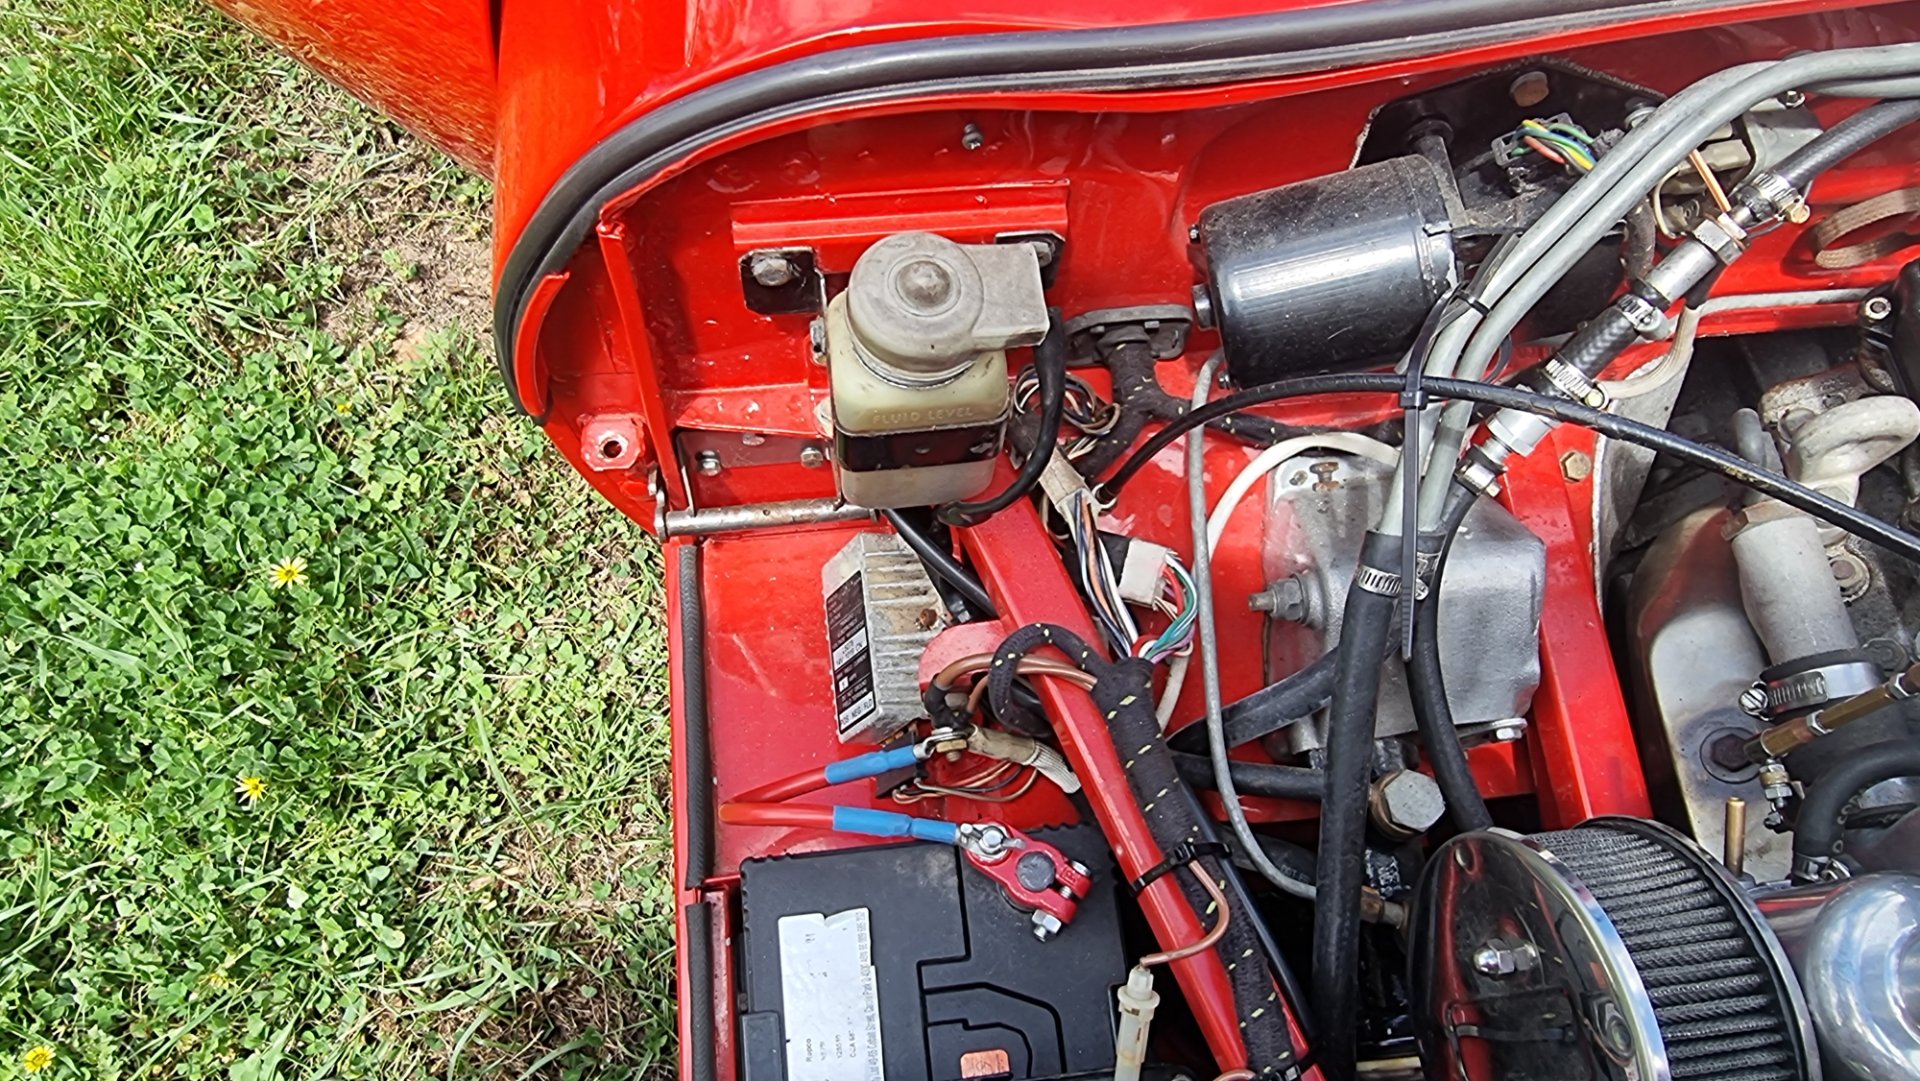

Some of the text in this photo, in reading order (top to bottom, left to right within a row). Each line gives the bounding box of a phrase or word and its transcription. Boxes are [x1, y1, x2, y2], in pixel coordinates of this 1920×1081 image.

[873, 407, 973, 425] FLUID LEVEL
[851, 704, 861, 720] NEG
